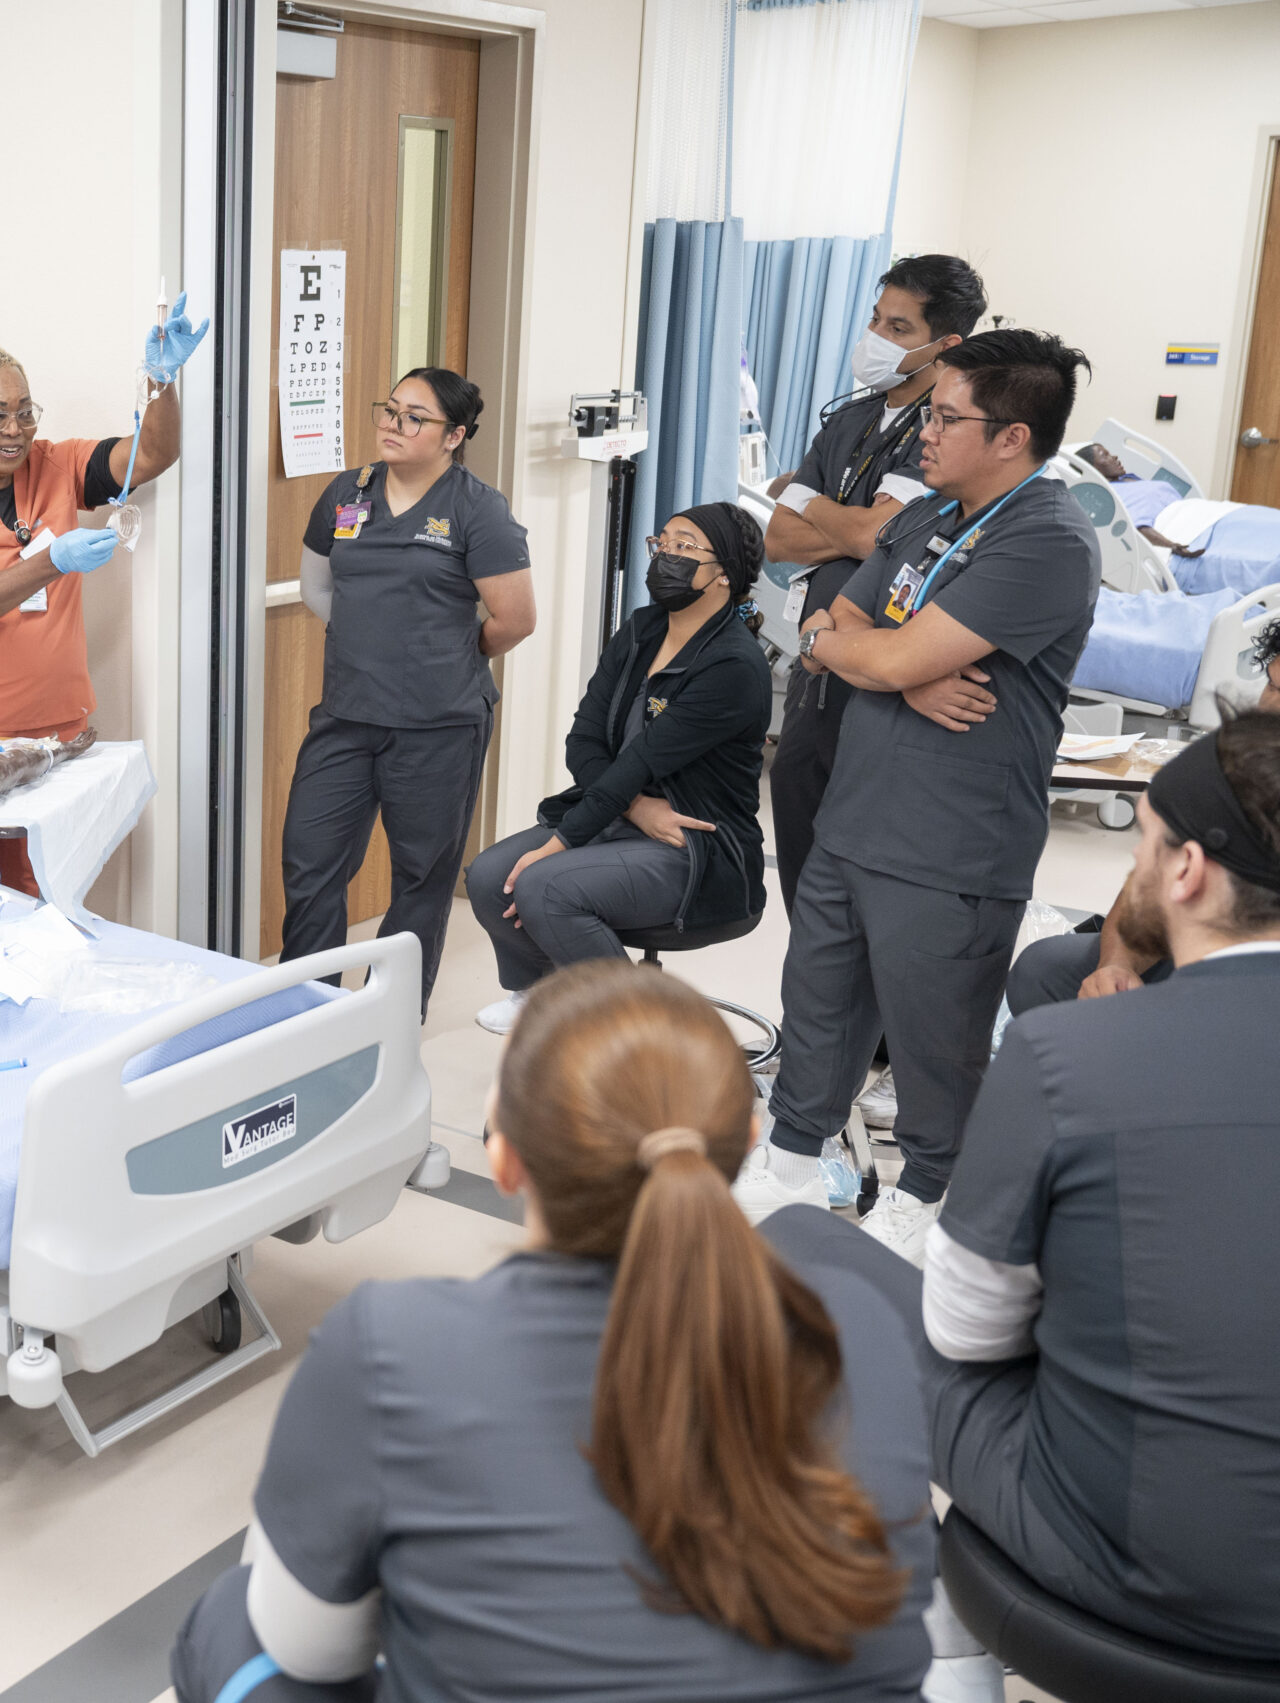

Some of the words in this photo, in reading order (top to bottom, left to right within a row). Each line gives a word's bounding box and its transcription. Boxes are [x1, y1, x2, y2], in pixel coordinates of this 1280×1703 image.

[300, 265, 321, 301] E
[336, 317, 341, 326] 2
[336, 342, 341, 351] 3
[336, 377, 341, 386] 5
[336, 388, 340, 397] 6
[335, 405, 340, 415] 7
[335, 419, 340, 429] 8
[335, 435, 340, 445] 9
[224, 1112, 294, 1154] VANTAGE
